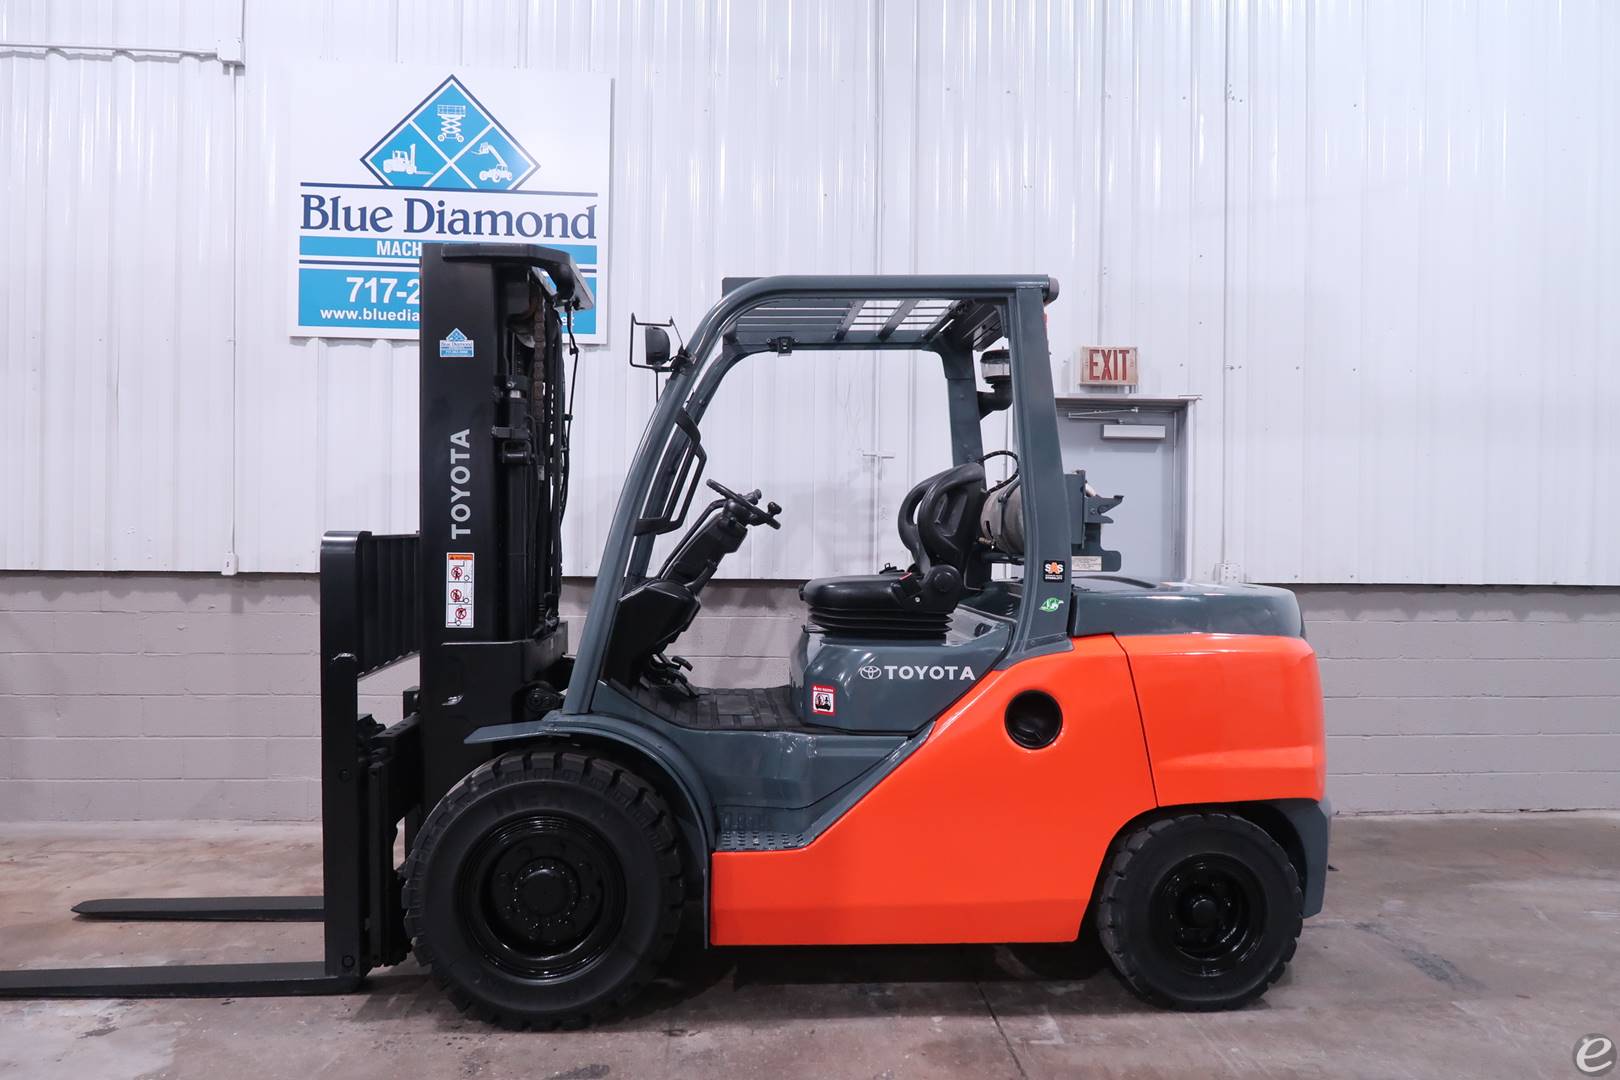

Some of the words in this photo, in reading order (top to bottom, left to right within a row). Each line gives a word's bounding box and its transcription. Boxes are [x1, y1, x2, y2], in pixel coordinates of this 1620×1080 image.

[300, 194, 393, 232] Blue
[403, 197, 597, 239] Diamond
[376, 240, 422, 257] MACH
[346, 276, 420, 305] 717-2
[1089, 349, 1129, 380] EXIT
[450, 428, 471, 540] TOYOTA
[884, 665, 976, 681] TOYOTA
